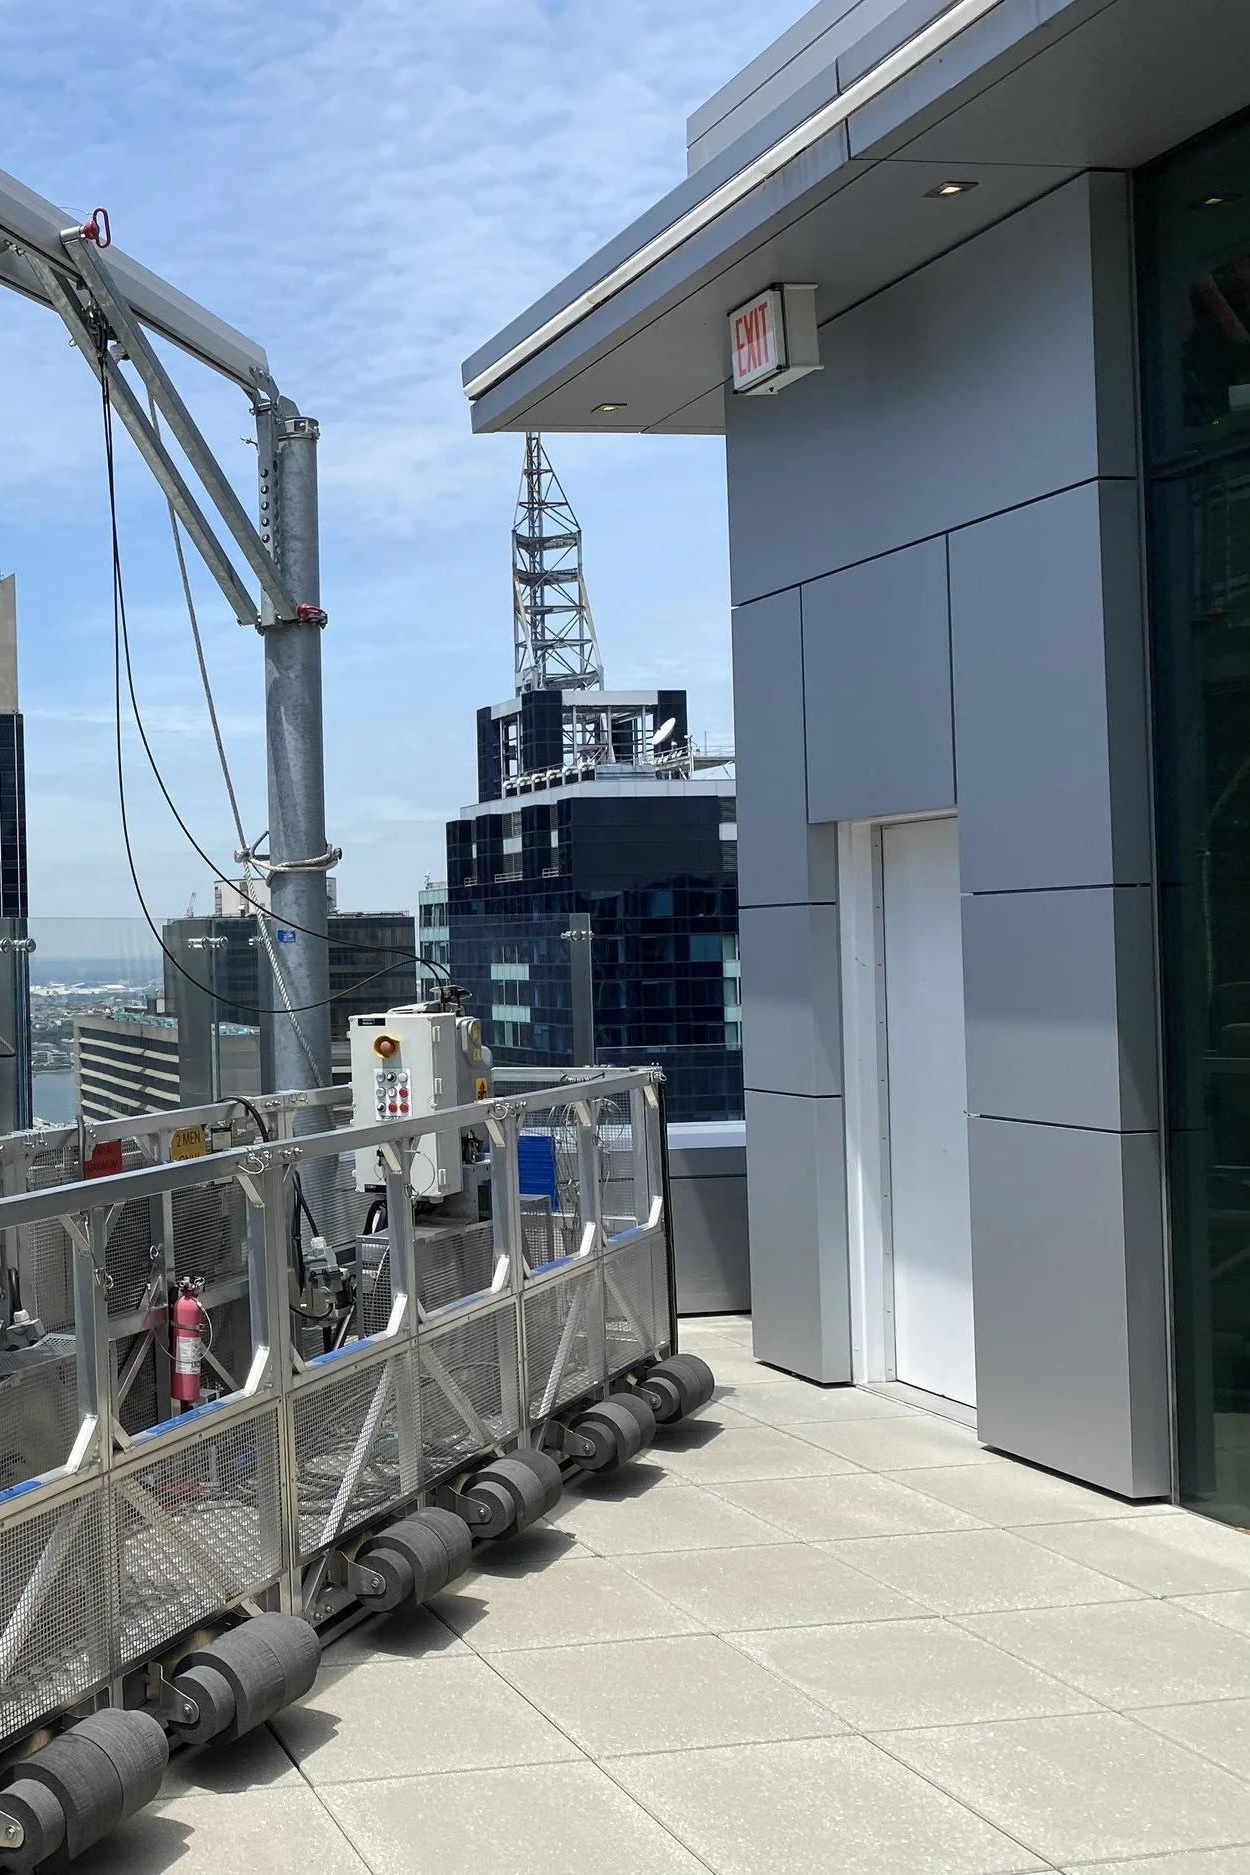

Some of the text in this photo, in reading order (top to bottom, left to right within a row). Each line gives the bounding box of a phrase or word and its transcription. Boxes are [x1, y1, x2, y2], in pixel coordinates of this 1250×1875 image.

[734, 301, 770, 378] EXIT
[176, 1134, 181, 1147] 2
[183, 1131, 201, 1146] MEN
